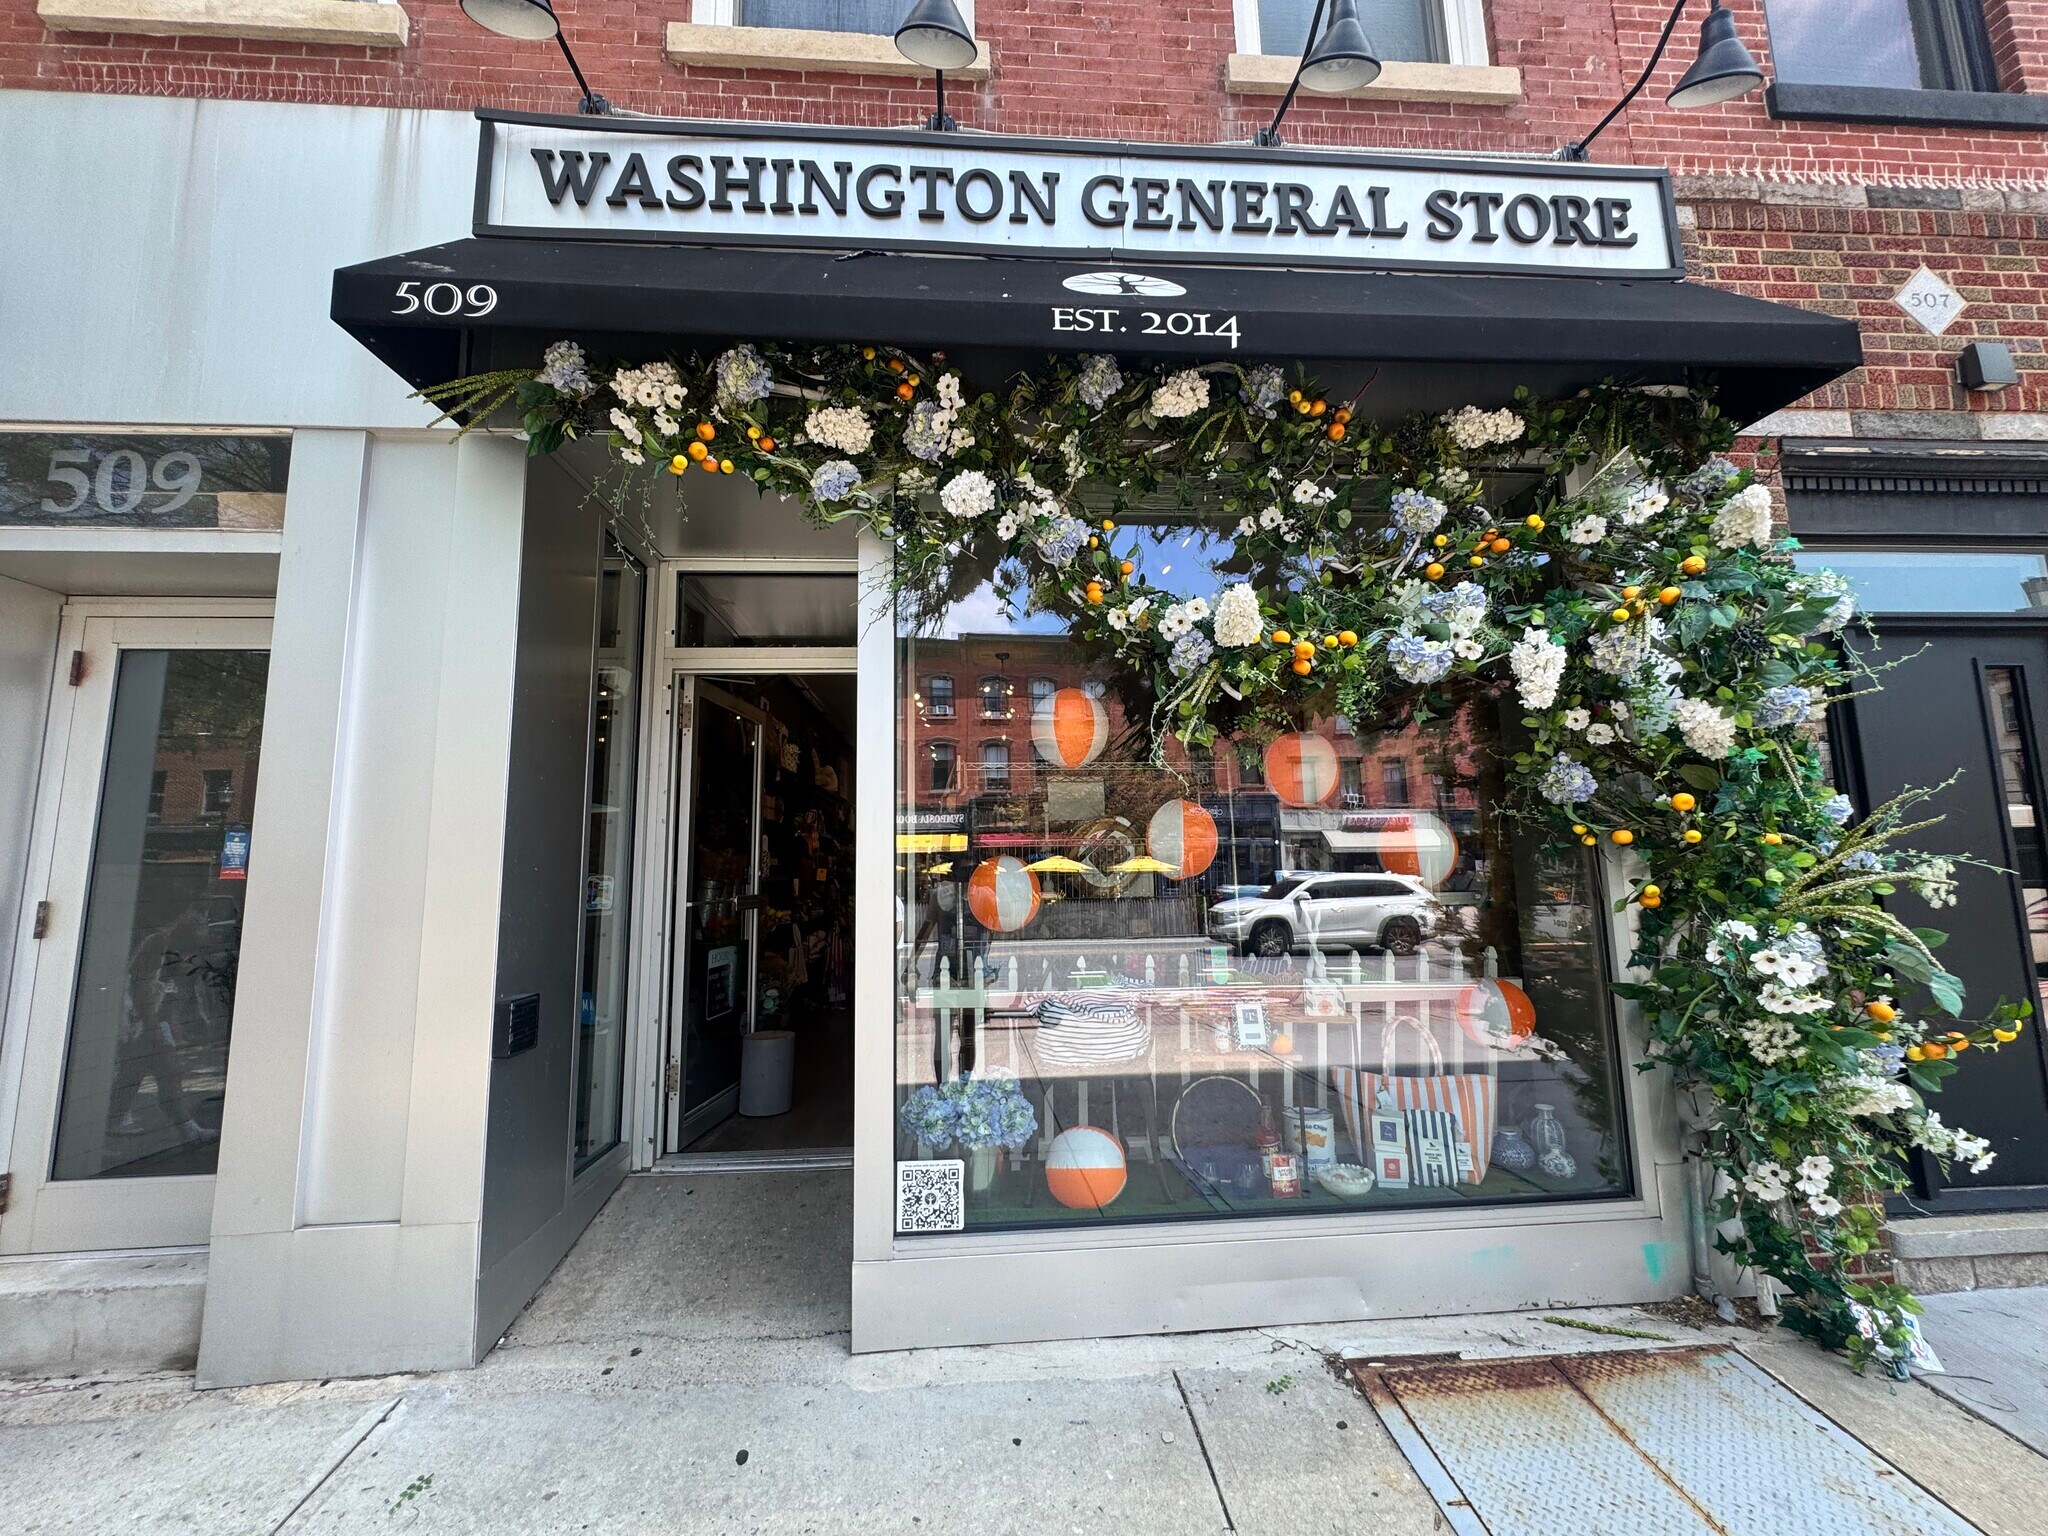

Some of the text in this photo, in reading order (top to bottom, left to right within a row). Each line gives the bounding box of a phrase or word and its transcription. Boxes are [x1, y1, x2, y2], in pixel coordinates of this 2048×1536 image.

[531, 147, 1639, 247] WASHINGTON GENERAL STORE
[392, 281, 499, 318] 509
[1911, 292, 1950, 308] 507
[1051, 307, 1242, 350] EST. 2014
[40, 448, 203, 515] 509
